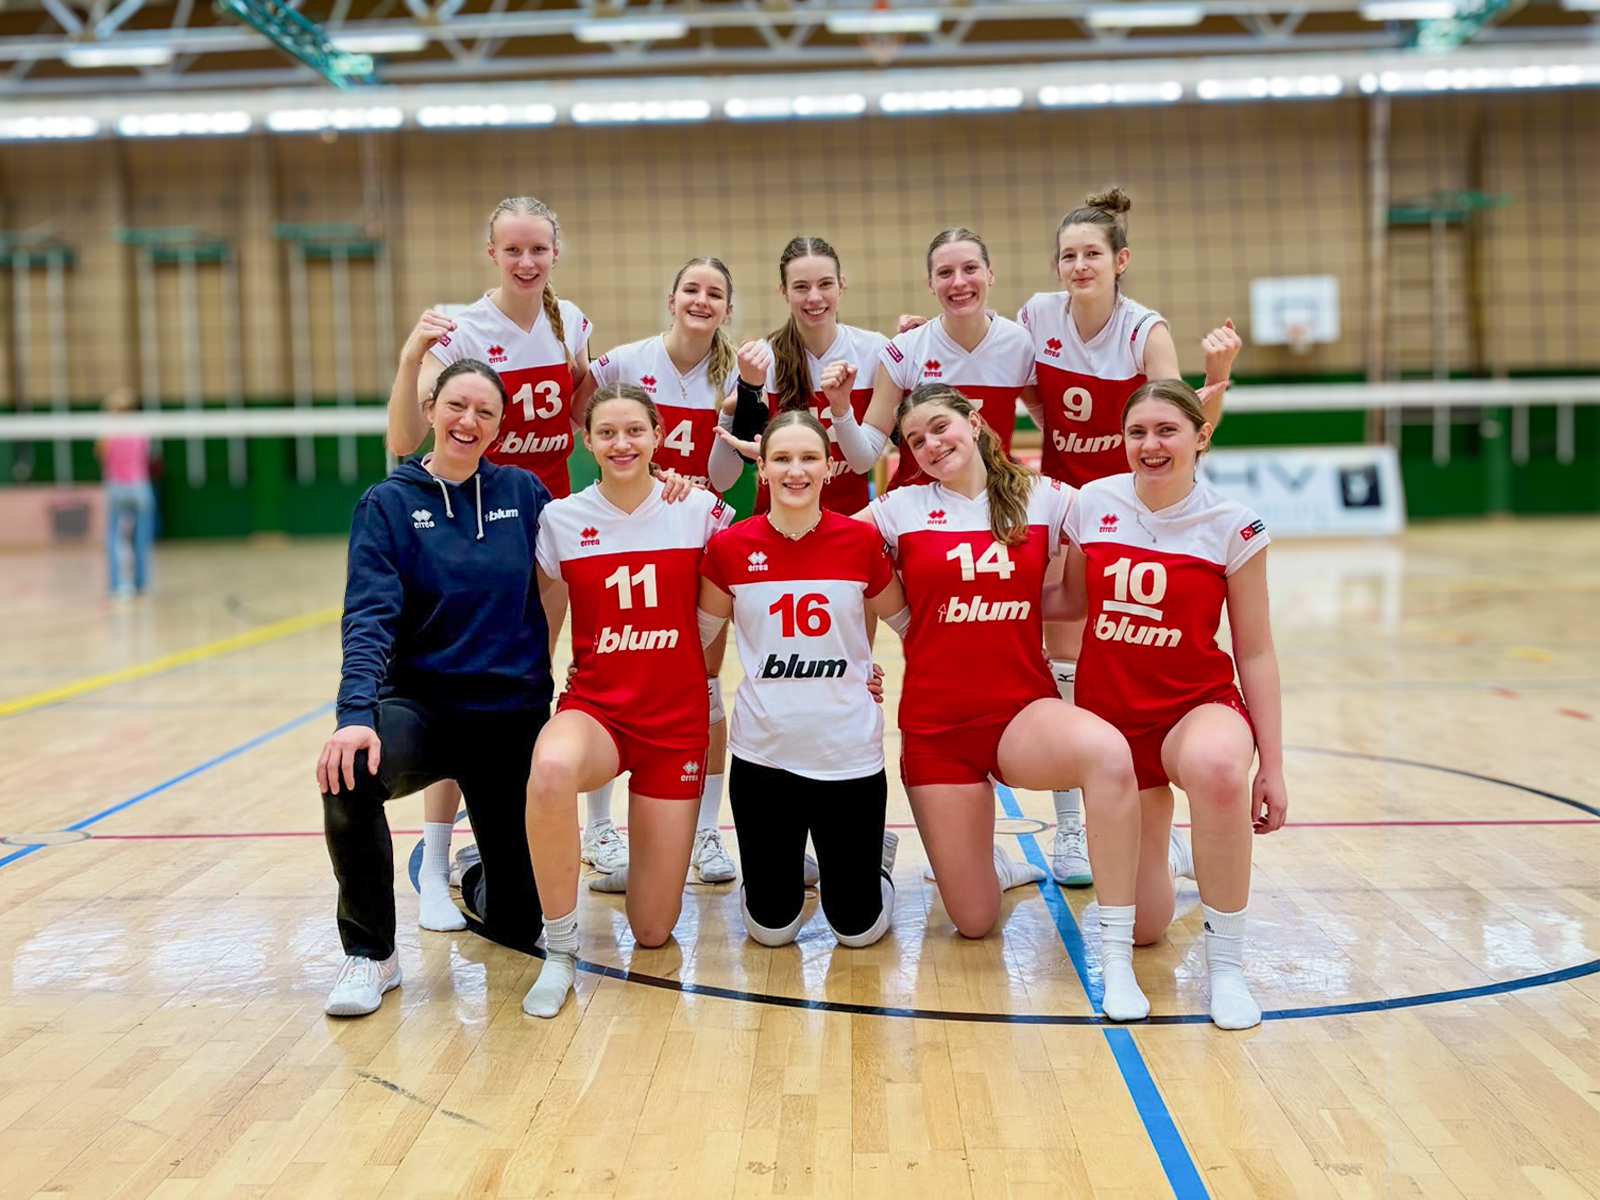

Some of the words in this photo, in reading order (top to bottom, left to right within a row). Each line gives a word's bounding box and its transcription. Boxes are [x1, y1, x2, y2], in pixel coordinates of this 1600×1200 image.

[512, 380, 563, 421] 13
[1062, 386, 1093, 422] 9
[499, 430, 569, 454] blum
[664, 419, 695, 457] 4
[1052, 429, 1123, 453] blum
[488, 508, 519, 522] blum
[946, 541, 1016, 581] 14
[604, 563, 658, 610] 11
[1103, 557, 1168, 605] 10
[768, 592, 832, 639] 16
[945, 595, 1031, 623] blum
[596, 624, 679, 654] blum
[1095, 613, 1183, 648] blum
[761, 653, 848, 679] blum
